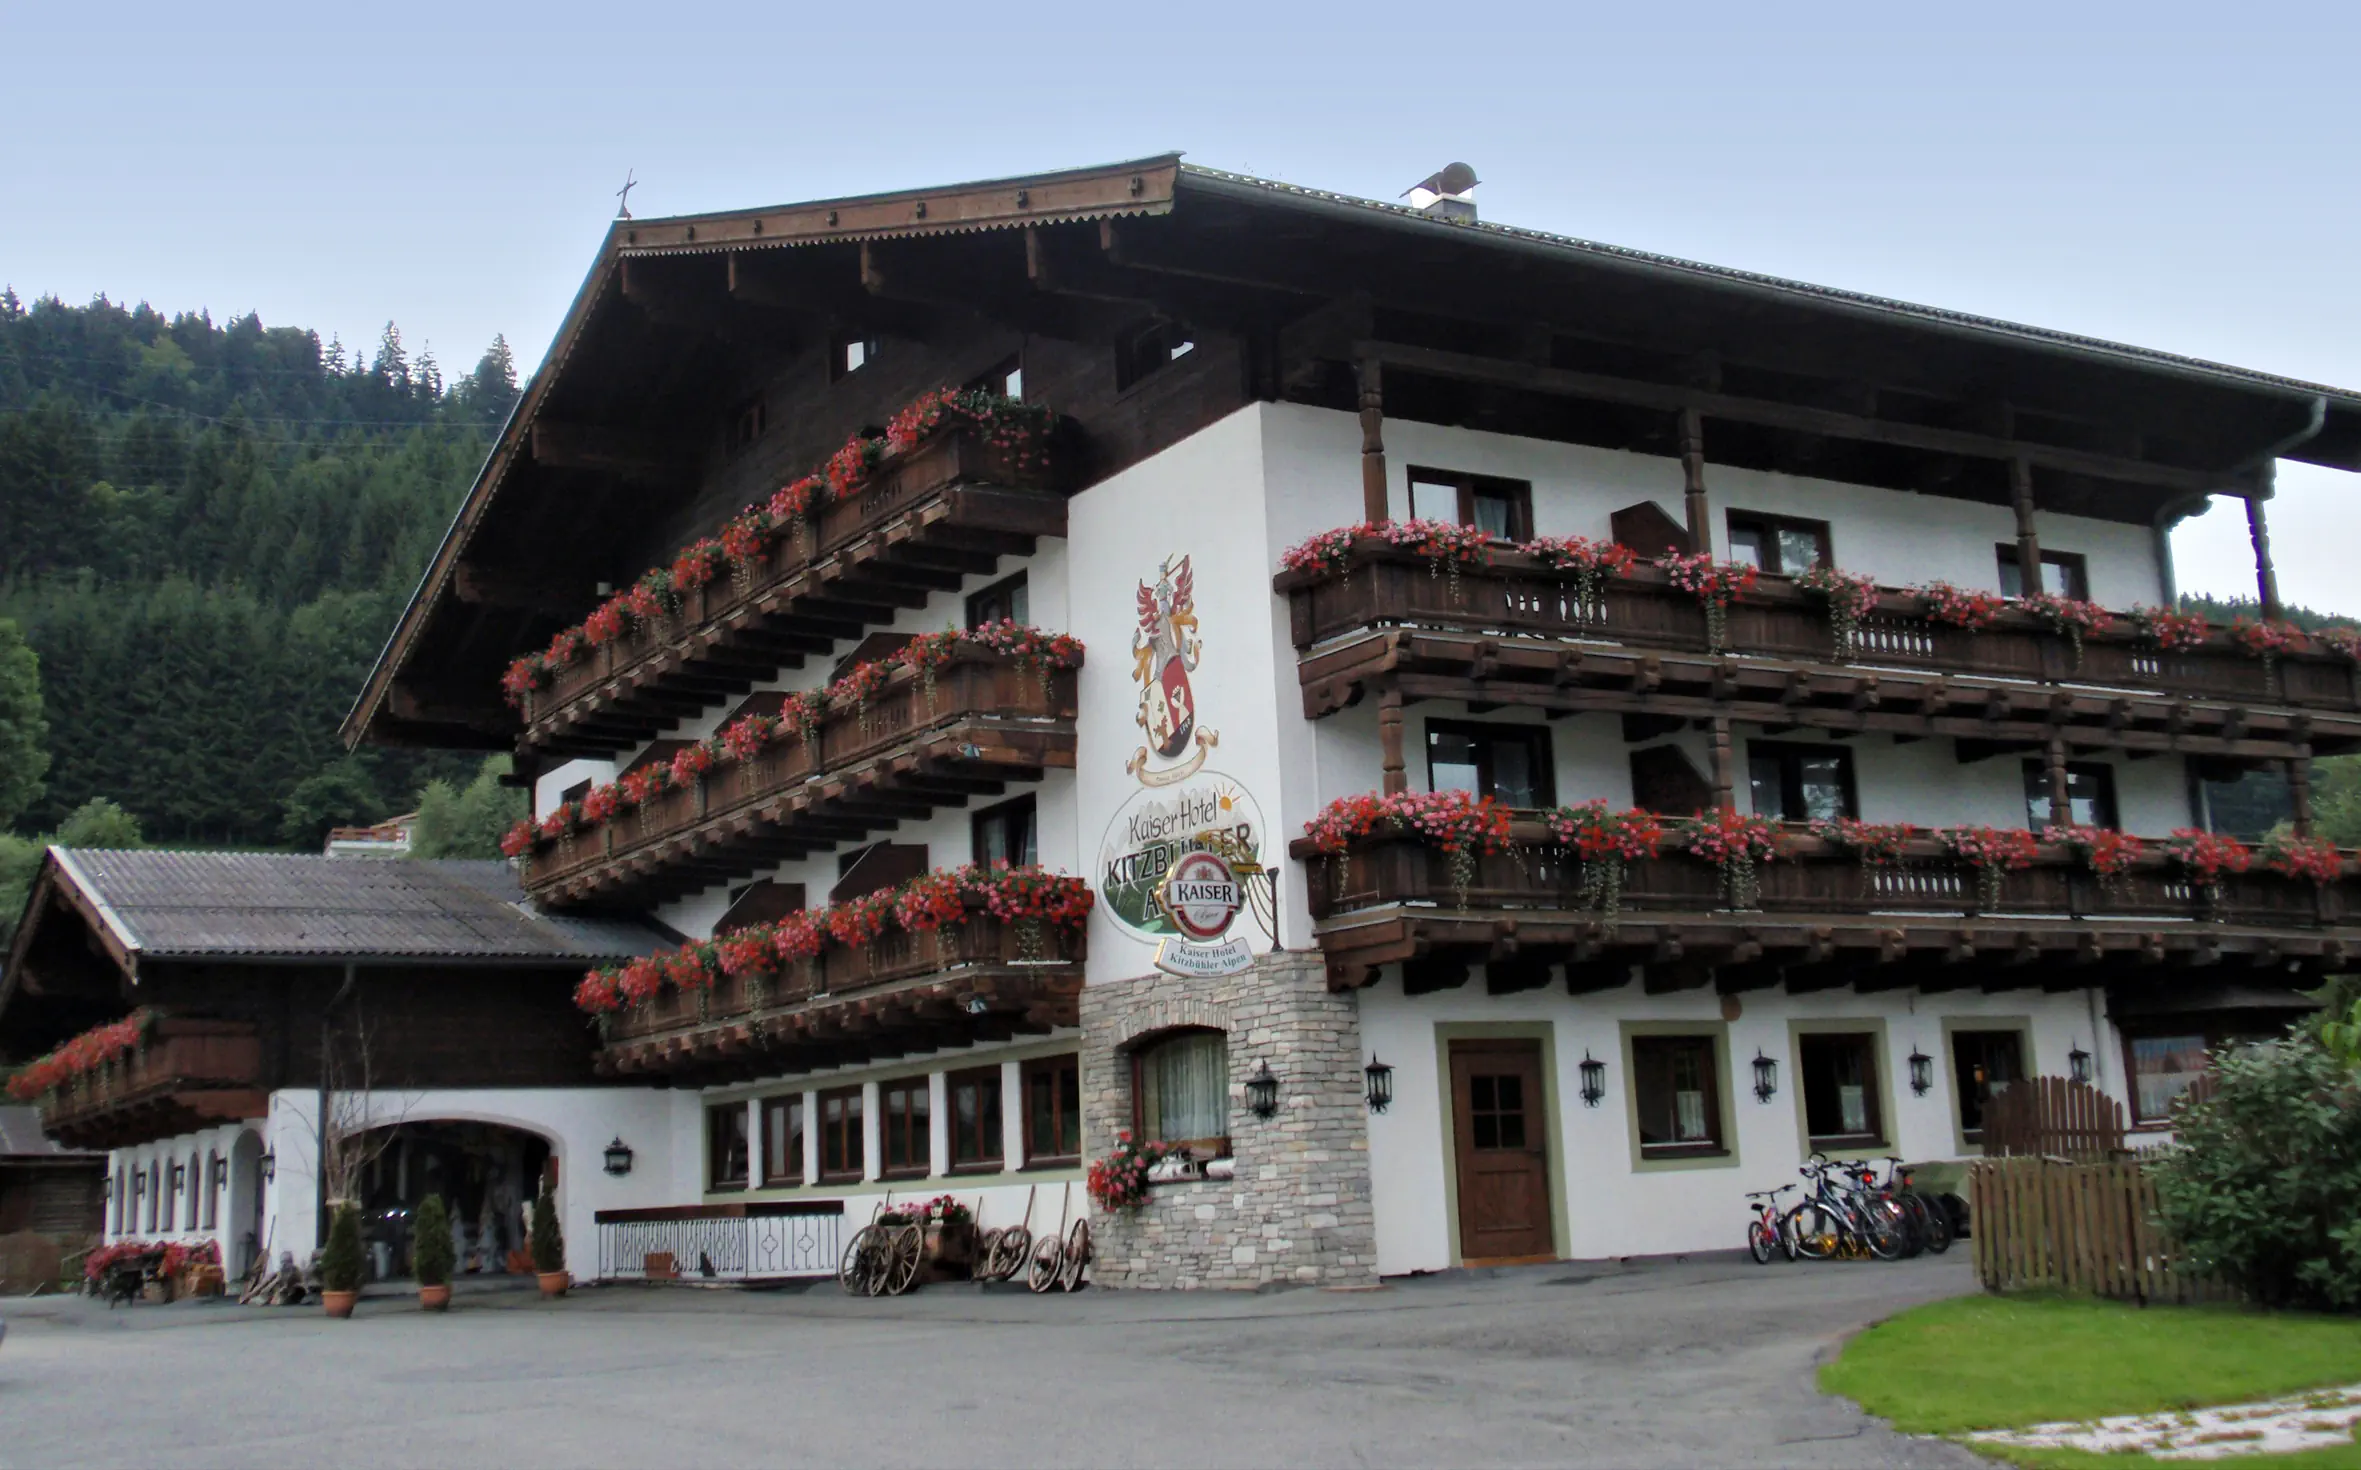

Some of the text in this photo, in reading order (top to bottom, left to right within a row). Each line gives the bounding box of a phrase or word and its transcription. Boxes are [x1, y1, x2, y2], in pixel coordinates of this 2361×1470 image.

[1128, 791, 1217, 843] Kaiser Hotel
[1178, 883, 1232, 902] KAISER
[1180, 945, 1236, 958] Kaiser Hotel
[1221, 954, 1247, 968] Alpen
